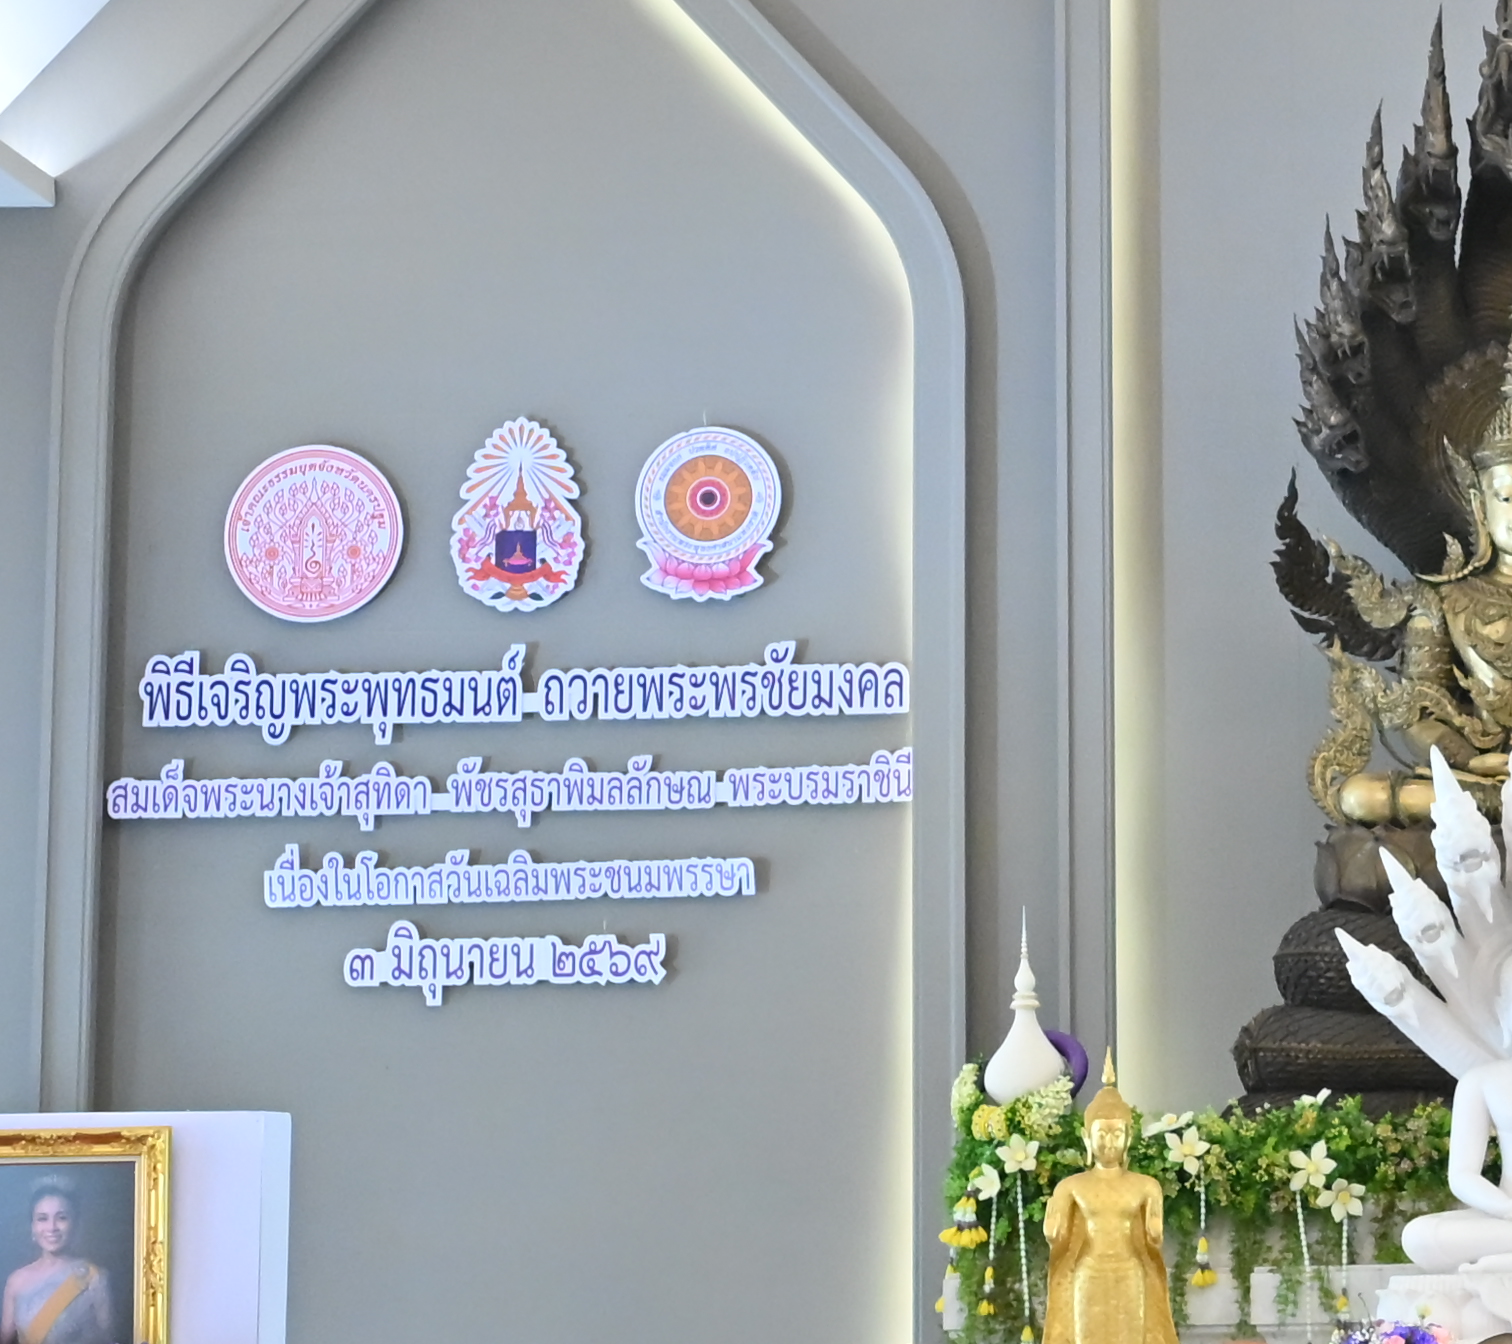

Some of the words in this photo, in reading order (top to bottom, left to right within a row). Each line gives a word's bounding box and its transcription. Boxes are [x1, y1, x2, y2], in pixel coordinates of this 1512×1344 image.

[143, 649, 520, 739] พิธีเจริญพระพุทธมนต์
[543, 646, 904, 716] ถวายพระพรชัยมงคล
[111, 762, 428, 826] สมเด็จพระนางเจ้าสุทิดา
[450, 758, 712, 823] พัชรสุธาพิมลลักษณ
[728, 750, 913, 803] พระบรมราชินี
[267, 849, 751, 903] เนื่องในโอกาสวันเฉลิมพระชนมพรรษา
[349, 953, 375, 981] ๓
[391, 925, 535, 1000] มิถุนายน
[550, 939, 661, 978] ๒๕๖๙
